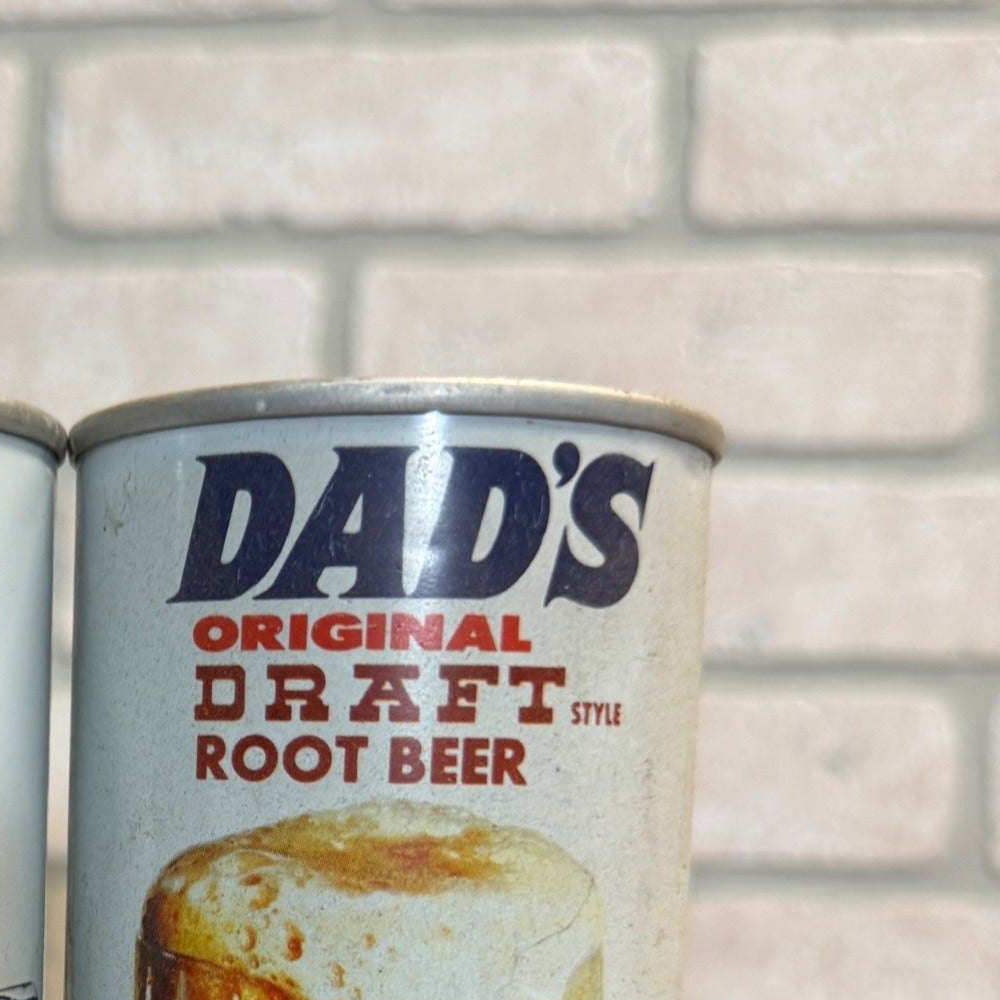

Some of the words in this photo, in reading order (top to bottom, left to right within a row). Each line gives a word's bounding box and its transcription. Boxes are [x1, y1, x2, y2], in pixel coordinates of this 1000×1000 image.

[166, 441, 655, 608] DAD'S
[192, 613, 532, 652] ORIGINAL
[194, 664, 566, 725] DRAFT
[571, 702, 622, 727] STYLE
[195, 734, 368, 783] ROOT
[388, 737, 527, 786] BEER
